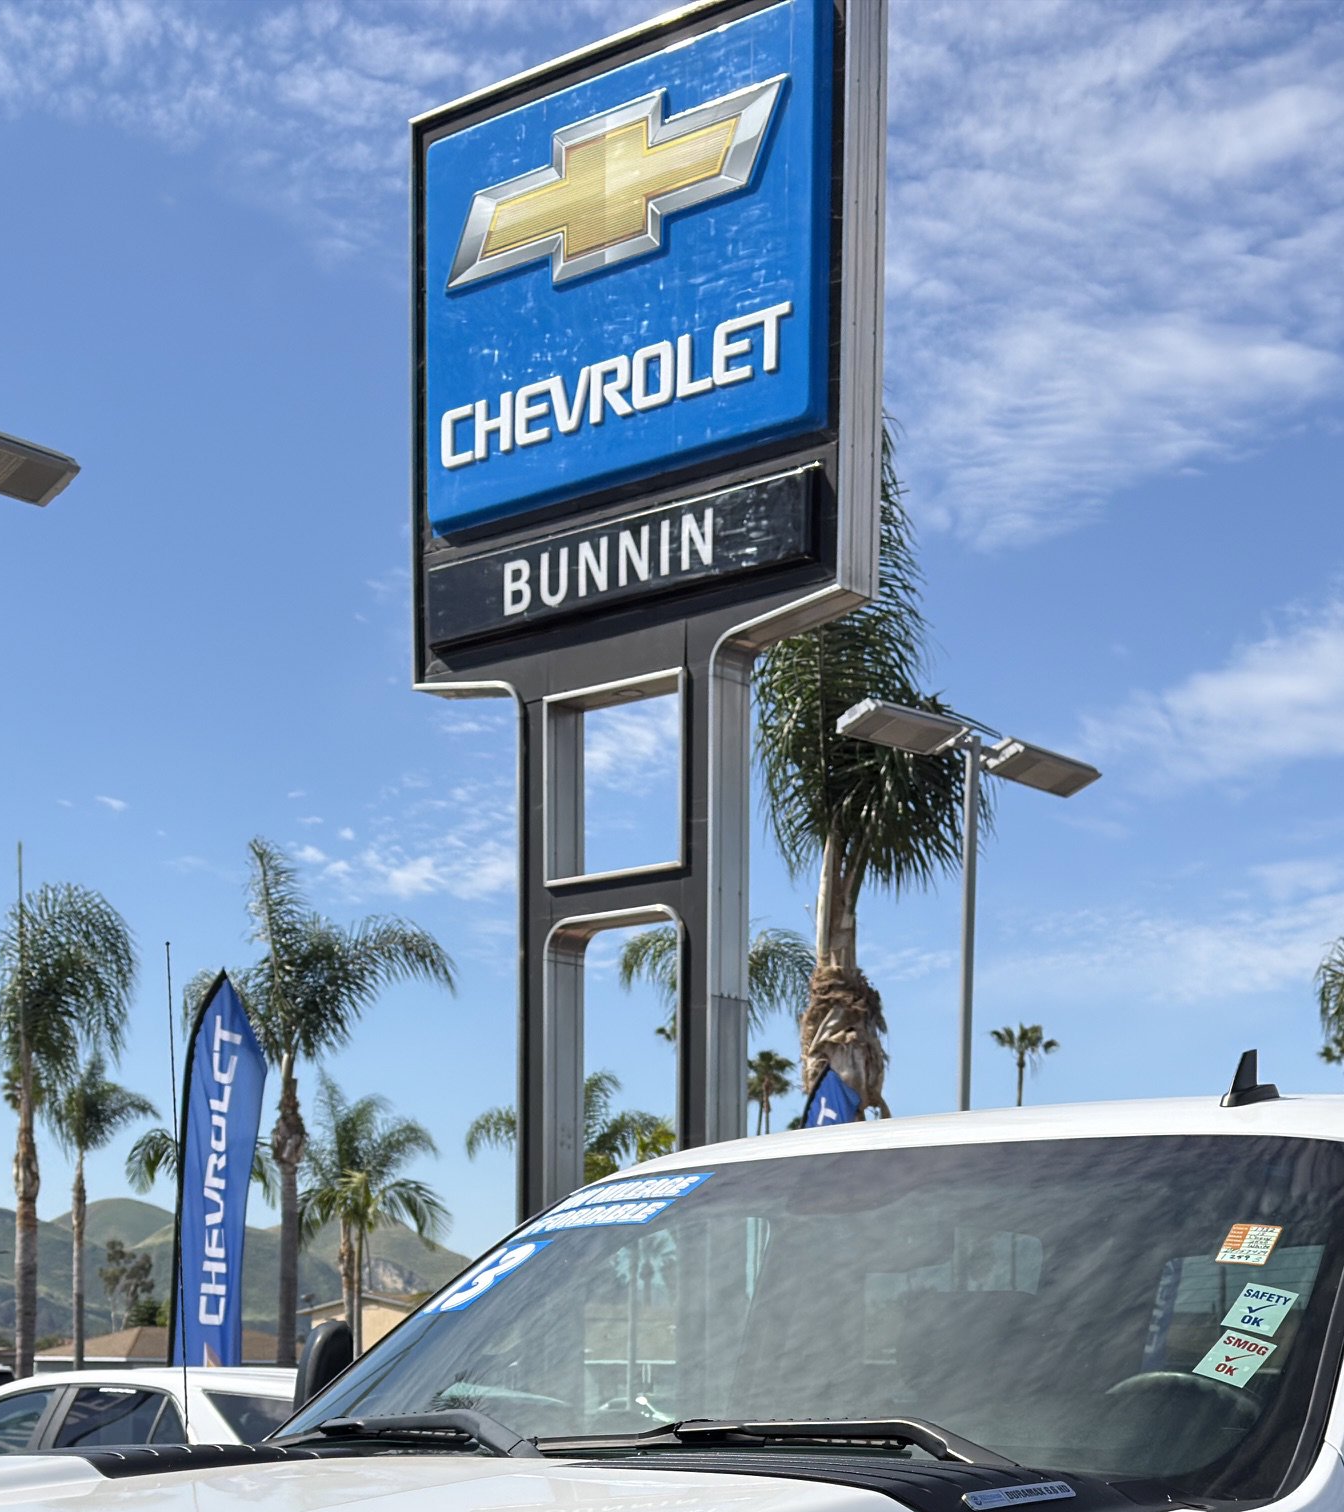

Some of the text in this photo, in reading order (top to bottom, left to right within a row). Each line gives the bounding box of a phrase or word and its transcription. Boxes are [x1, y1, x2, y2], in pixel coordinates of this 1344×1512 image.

[441, 301, 793, 468] CHEVROLET
[503, 507, 714, 617] BUNNIN
[1243, 1288, 1292, 1306] SAFETY
[1240, 1314, 1264, 1328] OK
[1222, 1335, 1269, 1357] SMOG
[1214, 1362, 1239, 1377] OK
[1004, 1487, 1047, 1500] DURAMAX
